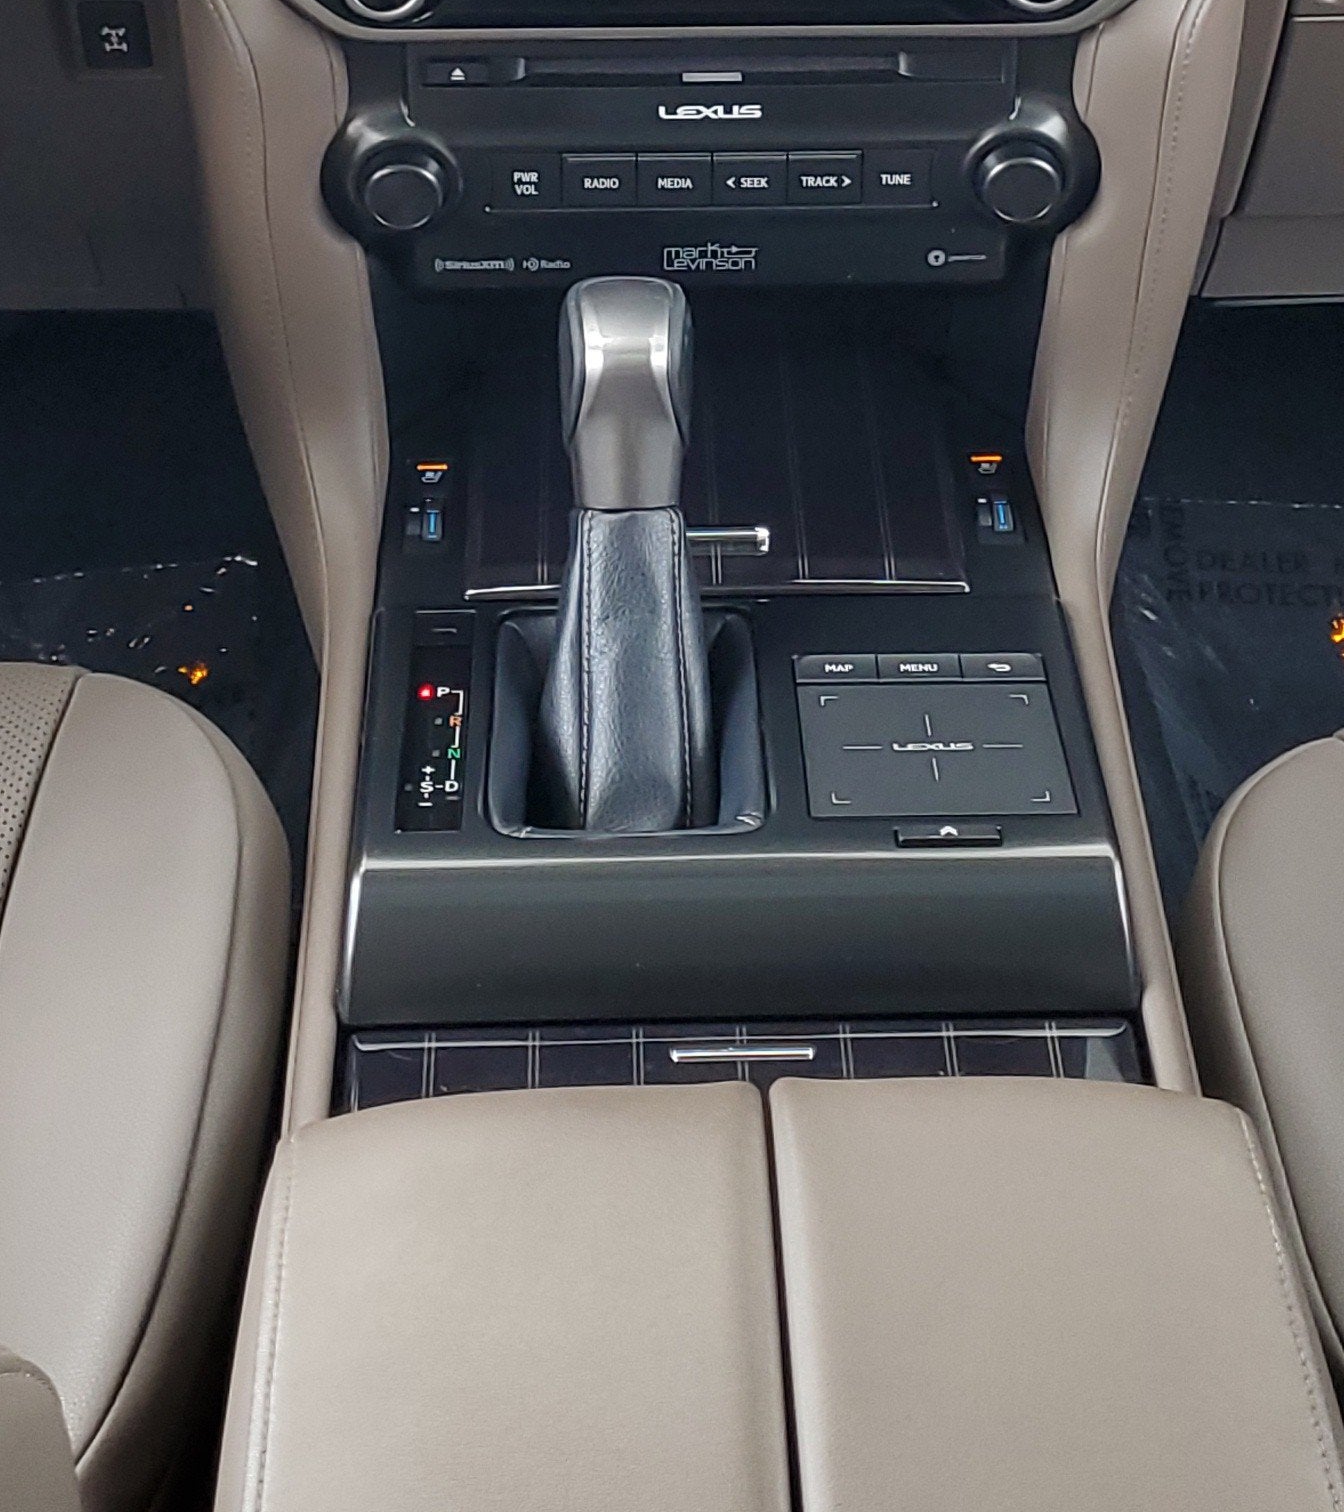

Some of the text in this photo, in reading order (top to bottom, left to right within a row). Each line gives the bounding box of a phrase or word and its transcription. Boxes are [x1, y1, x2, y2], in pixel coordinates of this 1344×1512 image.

[657, 104, 763, 120] LEXUS
[513, 171, 539, 183] PWR
[583, 177, 620, 189] RADIO
[657, 177, 693, 189] MEDIA
[740, 177, 769, 188] SEEK
[800, 176, 838, 188] TRACK
[880, 173, 912, 186] TUNE
[514, 184, 539, 195] VOL
[824, 663, 854, 673] MAP
[899, 663, 938, 673] MENU
[436, 686, 451, 698] P
[448, 714, 463, 728] R
[891, 741, 975, 751] LEXUS
[447, 748, 461, 759] N
[419, 780, 459, 793] S D
